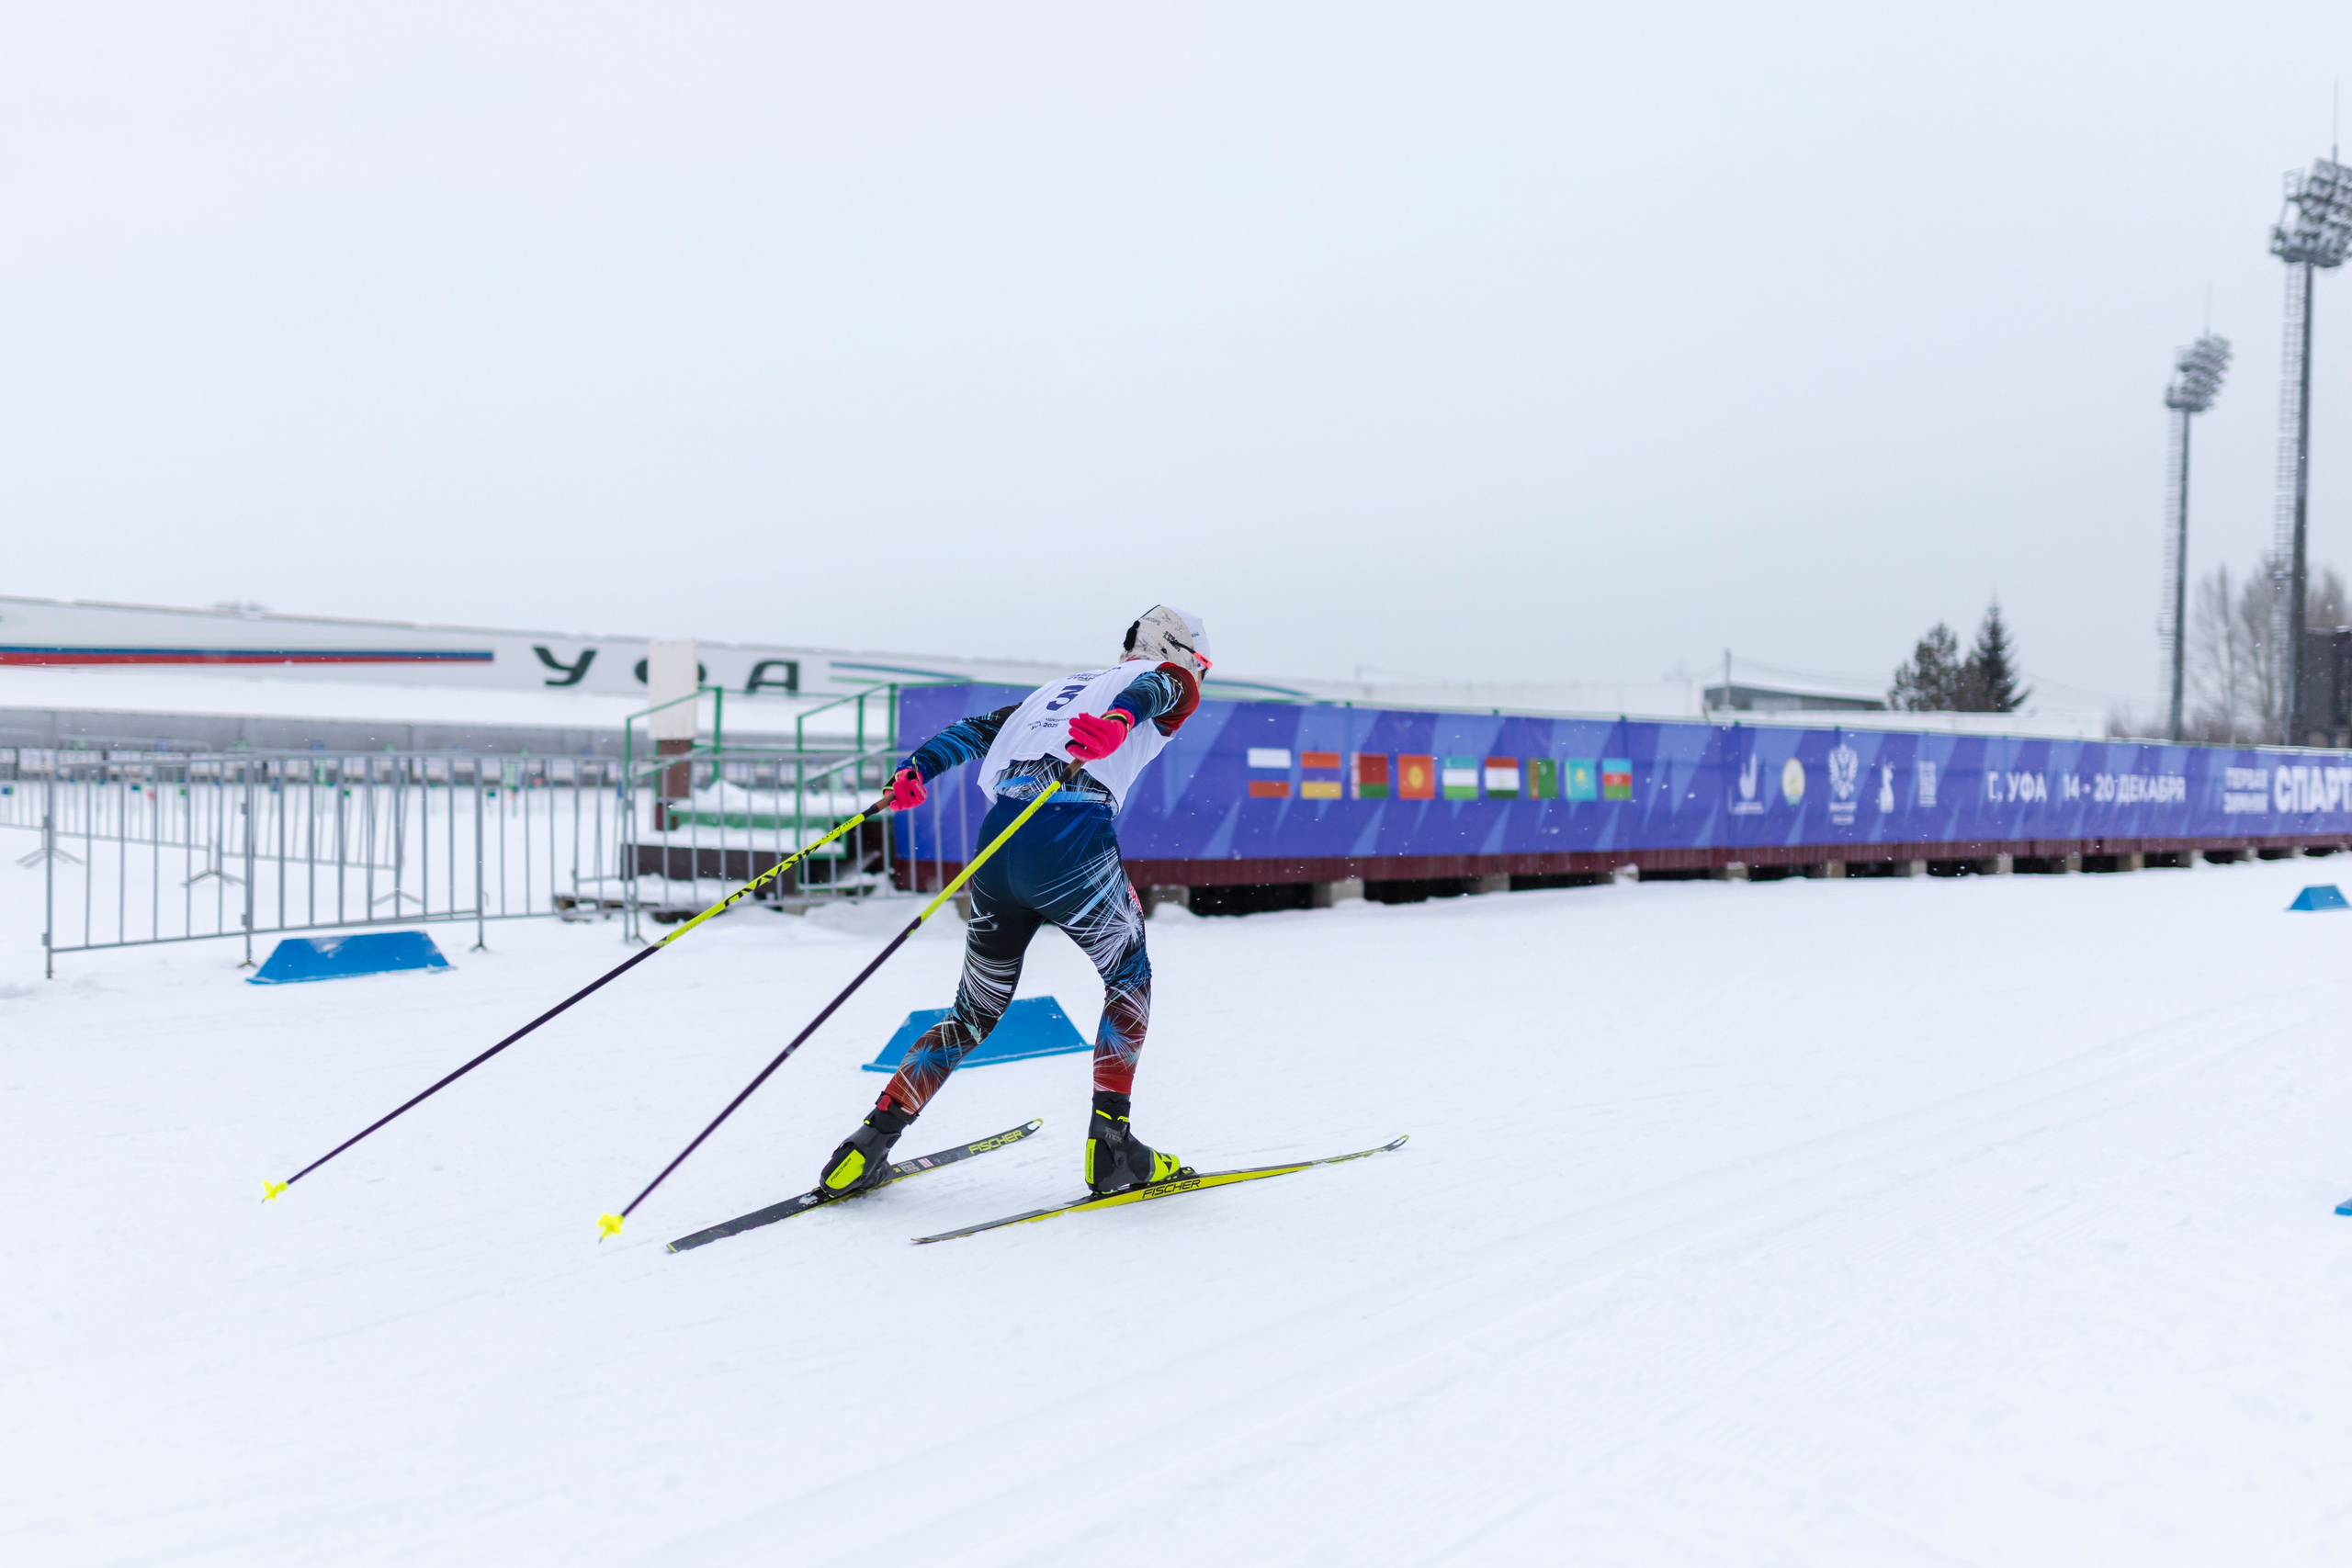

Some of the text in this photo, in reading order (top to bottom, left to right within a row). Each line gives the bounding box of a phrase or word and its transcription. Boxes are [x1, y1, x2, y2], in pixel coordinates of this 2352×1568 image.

[1046, 685, 1088, 711] 3
[2007, 771, 2047, 804] УФА
[2094, 773, 2114, 802] 20
[2116, 773, 2186, 807] ДЕКАБРЯ
[968, 1129, 1024, 1155] FISCHER
[831, 1157, 852, 1182] FISCHER
[1142, 1179, 1201, 1199] FISCHER
